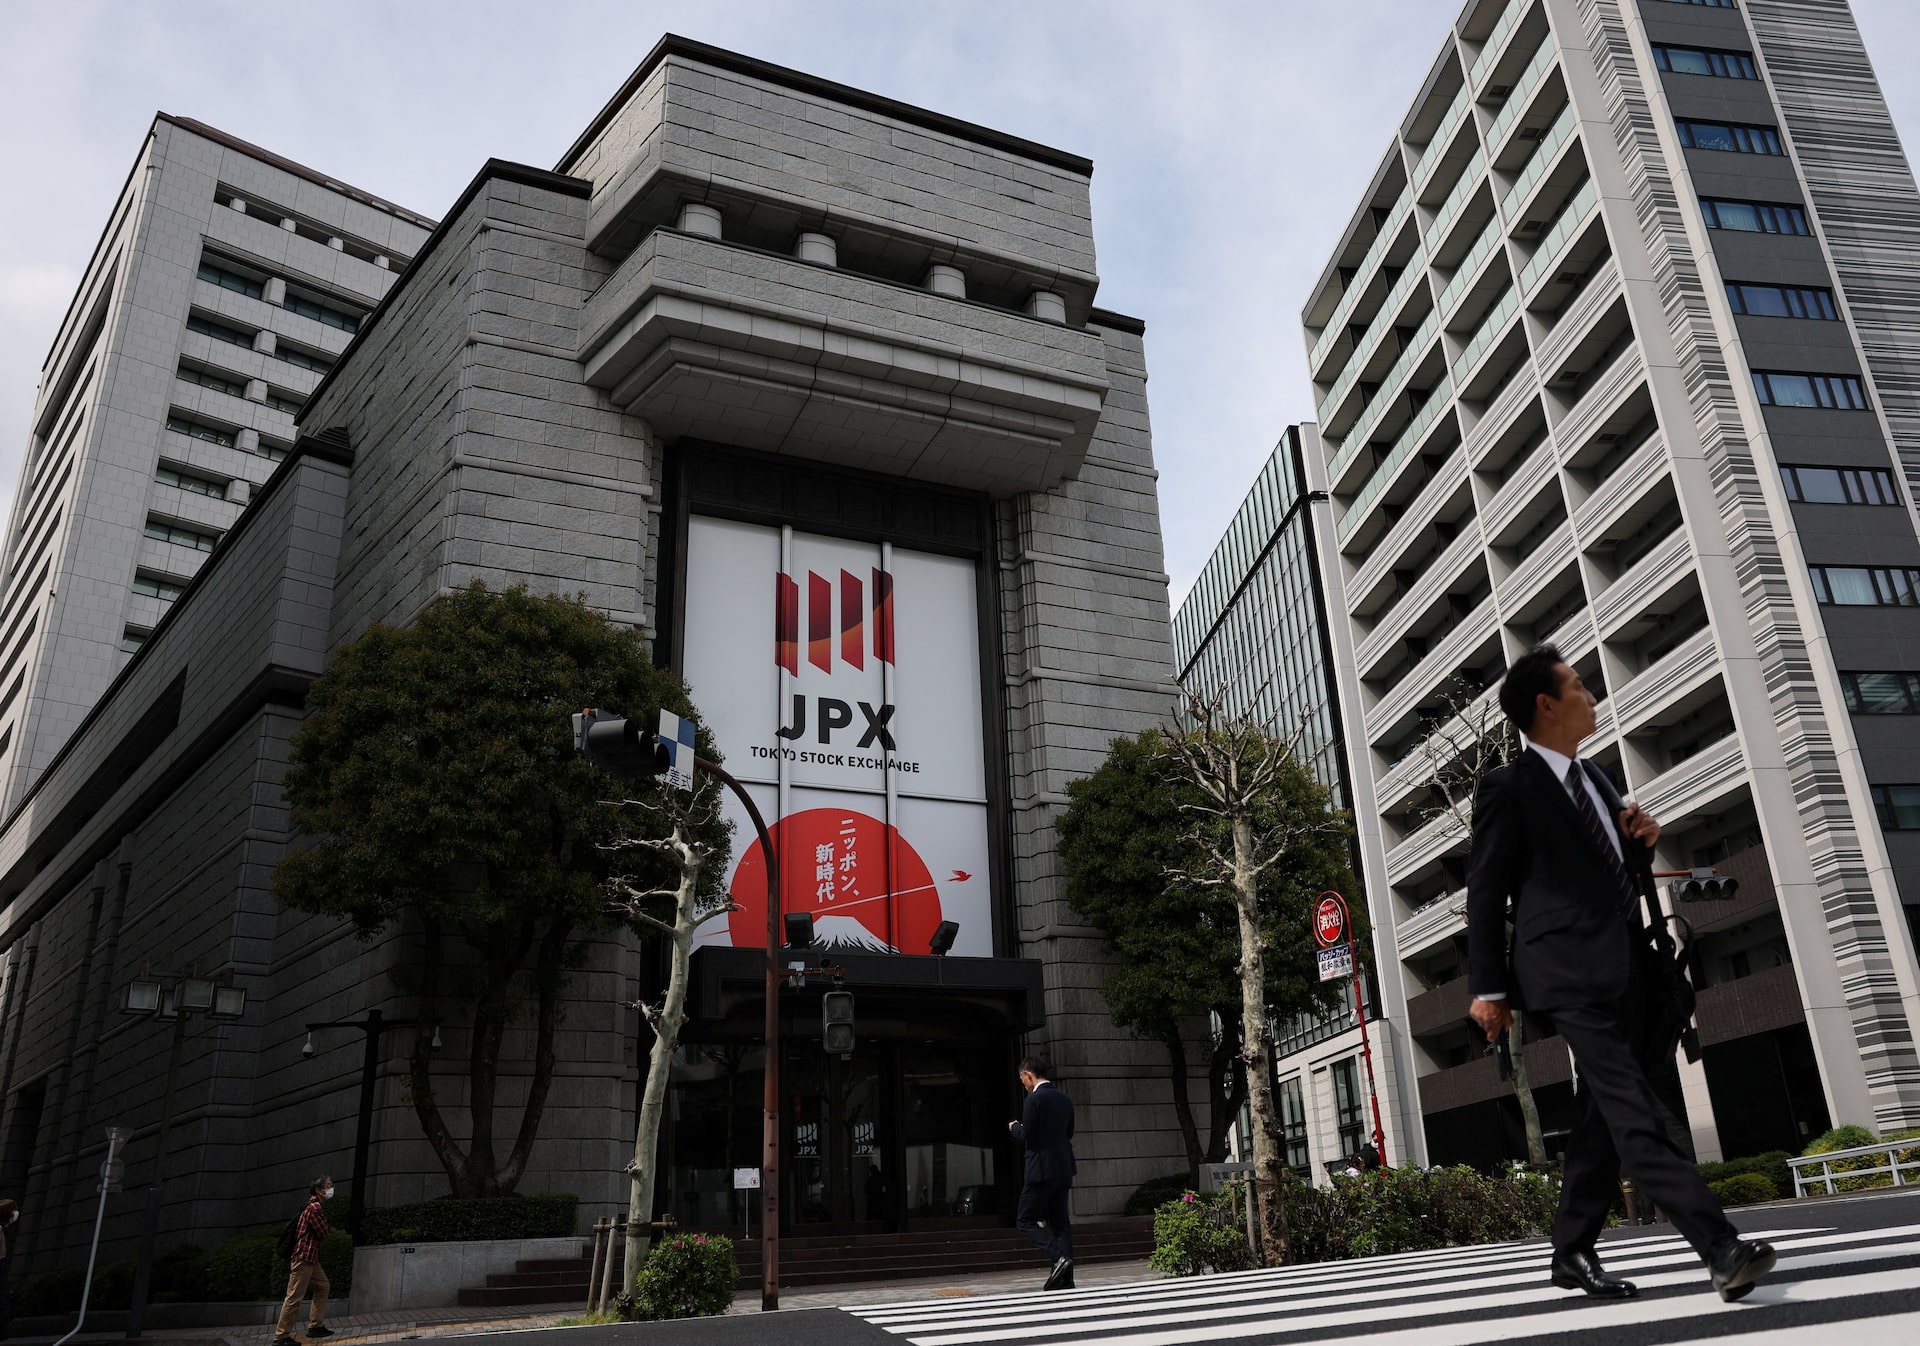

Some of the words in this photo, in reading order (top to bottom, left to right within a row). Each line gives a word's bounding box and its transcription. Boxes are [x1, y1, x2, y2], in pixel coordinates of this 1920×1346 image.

[774, 694, 896, 751] JPX
[751, 746, 796, 761] TOKYO
[800, 751, 844, 766] STOCK
[848, 756, 920, 773] EXCHANGE
[816, 842, 835, 903] 新時代
[1320, 911, 1341, 931] 消火栓
[798, 1146, 817, 1155] JPX
[855, 1145, 874, 1154] JPX
